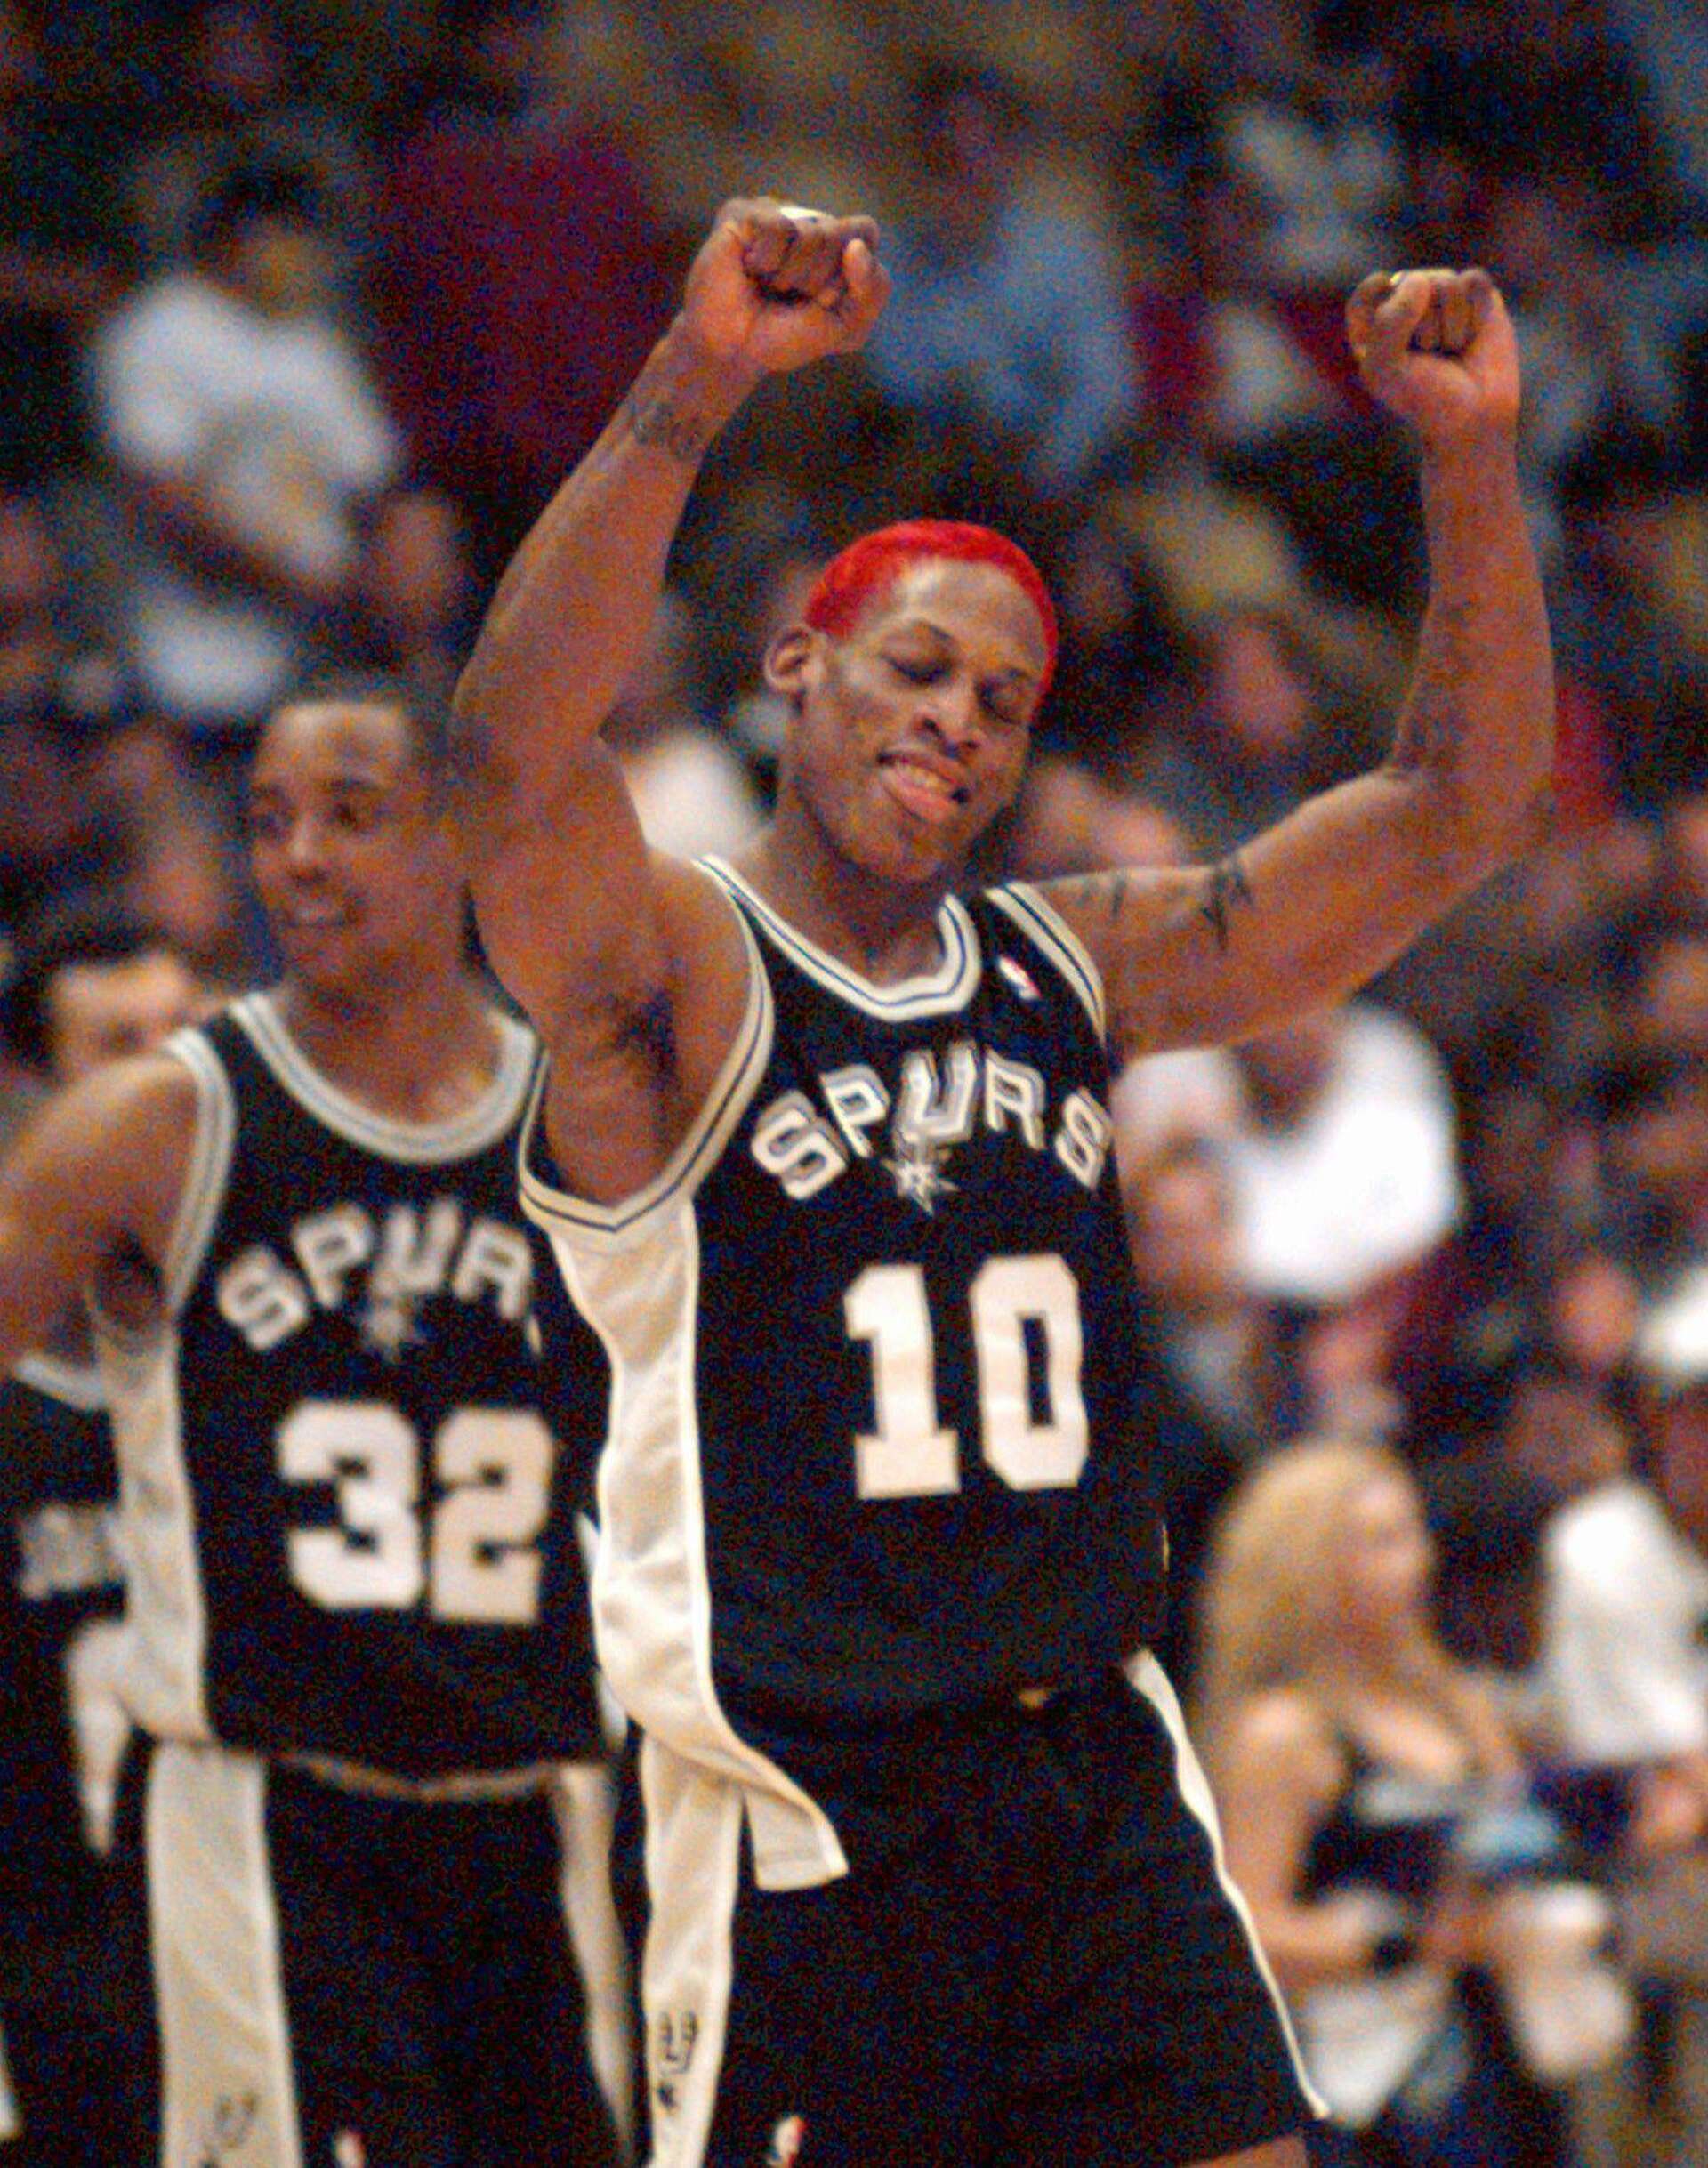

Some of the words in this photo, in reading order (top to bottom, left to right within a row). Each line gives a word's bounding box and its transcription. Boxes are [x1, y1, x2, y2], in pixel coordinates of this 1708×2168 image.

[749, 1040, 1113, 1200] SPURS
[217, 1198, 543, 1352] SPUR
[842, 1253, 1089, 1500] 10
[278, 1399, 554, 1623] 32
